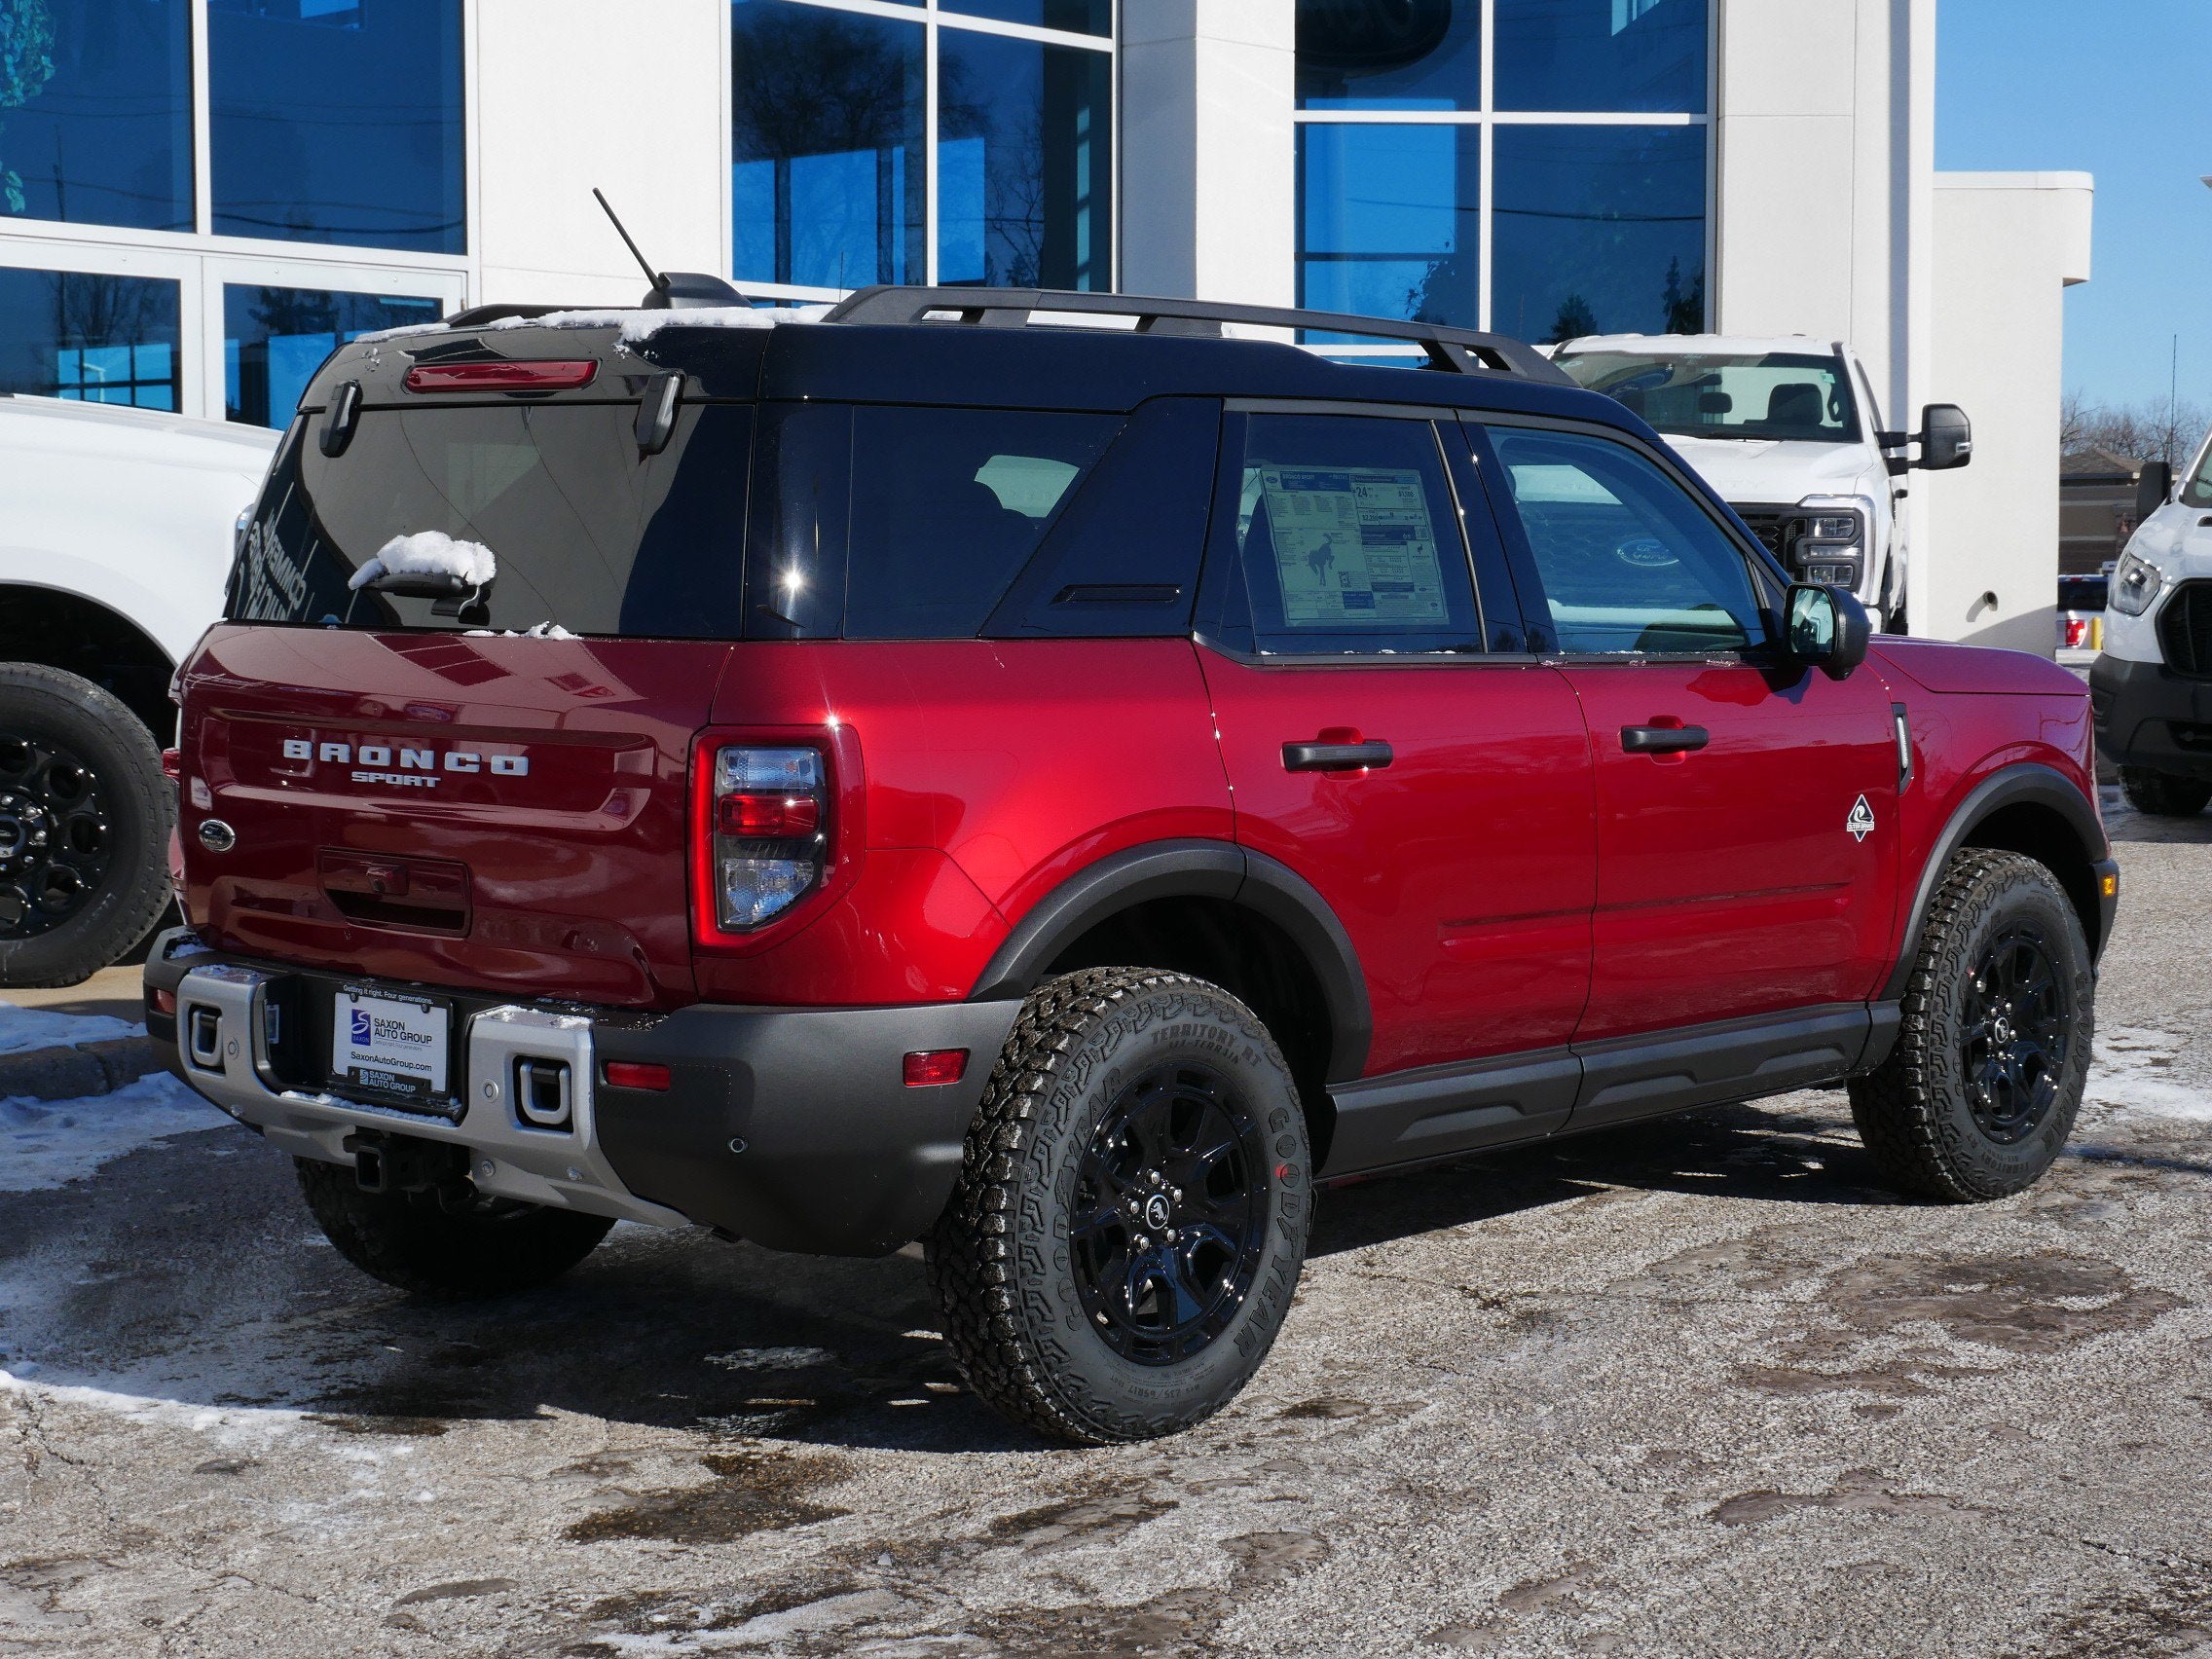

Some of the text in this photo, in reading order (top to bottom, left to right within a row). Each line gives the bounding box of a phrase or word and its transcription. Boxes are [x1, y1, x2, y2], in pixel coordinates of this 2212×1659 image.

[283, 739, 529, 776] BRONCO
[351, 771, 441, 788] SPORT
[343, 984, 363, 996] Getting
[374, 1017, 405, 1031] SAXON
[374, 1029, 432, 1044] AUTO GROUP
[1151, 1023, 1237, 1048] TERRITORY
[350, 1051, 432, 1071] SaxonAutoGroup.com
[369, 1071, 395, 1082] SAXON
[369, 1078, 416, 1092] AUTO GROUP
[1233, 1107, 1300, 1358] GOODYEAR
